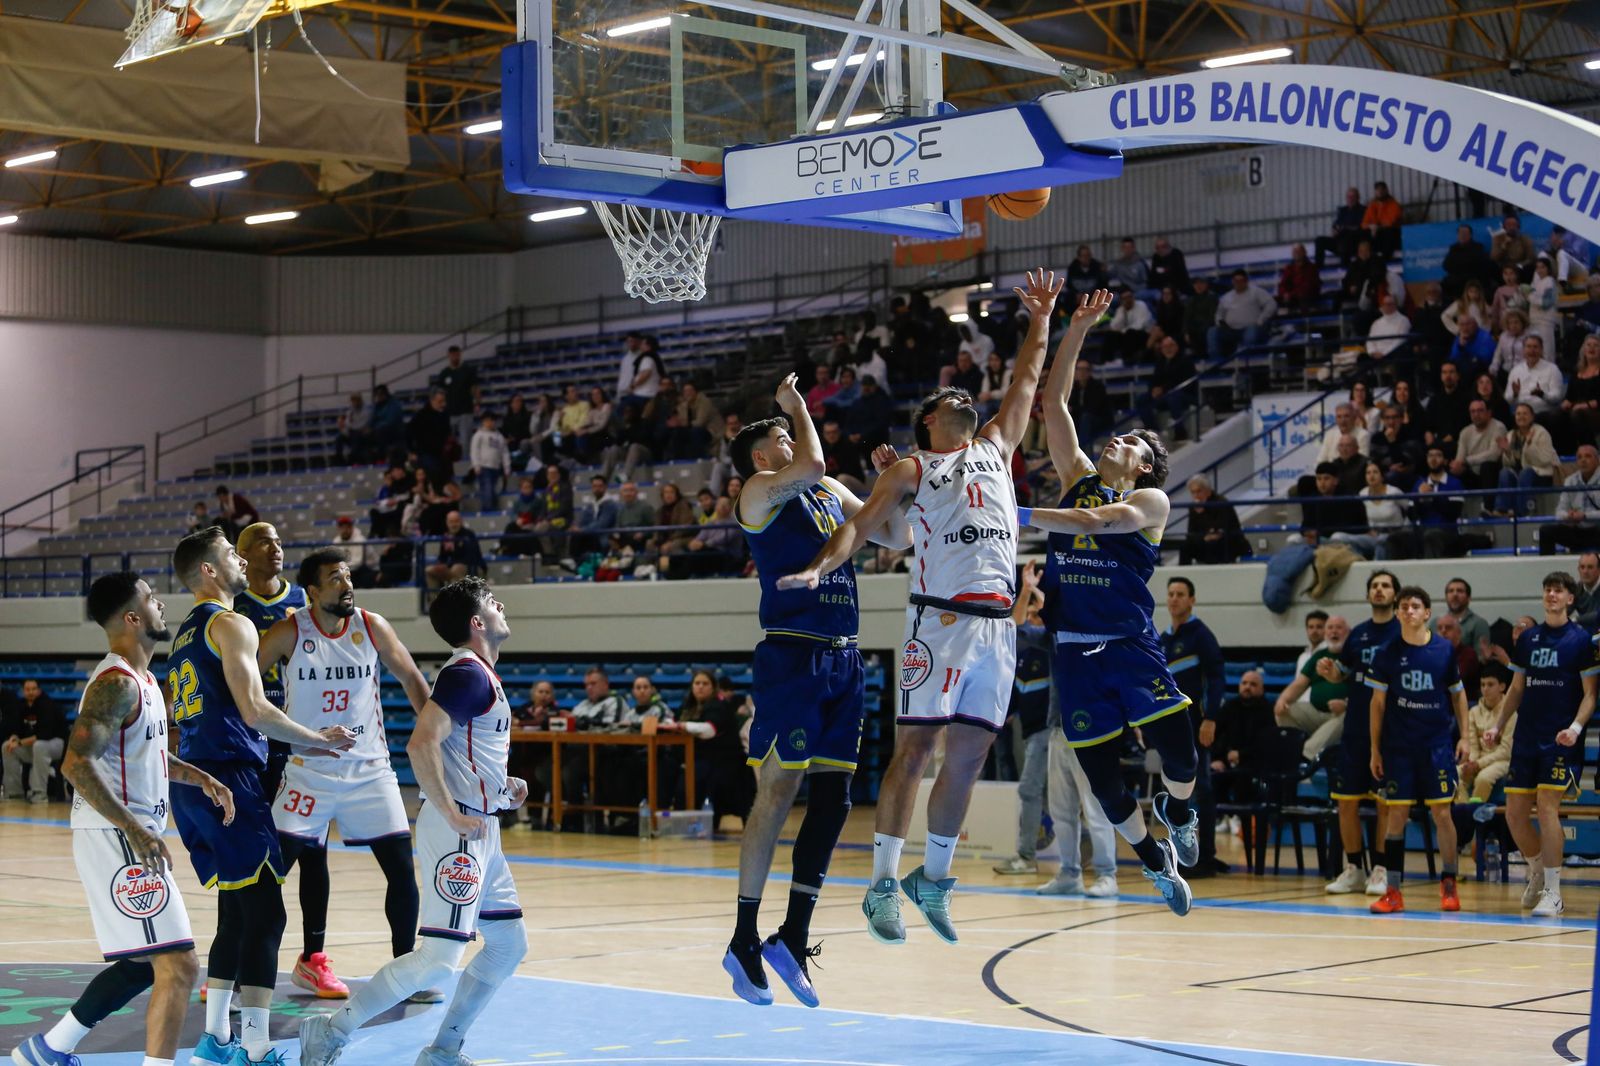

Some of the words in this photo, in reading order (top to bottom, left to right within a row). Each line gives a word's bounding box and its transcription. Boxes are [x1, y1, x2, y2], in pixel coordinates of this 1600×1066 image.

[1109, 83, 1197, 130] CLUB
[1209, 81, 1452, 152] BALONCESTO
[814, 168, 920, 196] CENTER
[1249, 157, 1263, 186] B
[928, 475, 952, 491] LA
[956, 460, 1002, 477] ZUBIA
[966, 482, 985, 508] 11
[1530, 648, 1559, 668] CBA
[298, 666, 317, 681] LA
[325, 664, 372, 681] ZUBIA
[1401, 670, 1434, 692] CBA
[168, 657, 204, 726] 22
[321, 689, 350, 713] 33
[1551, 767, 1567, 780] 35
[283, 789, 316, 818] 33
[127, 880, 164, 896] Zubia
